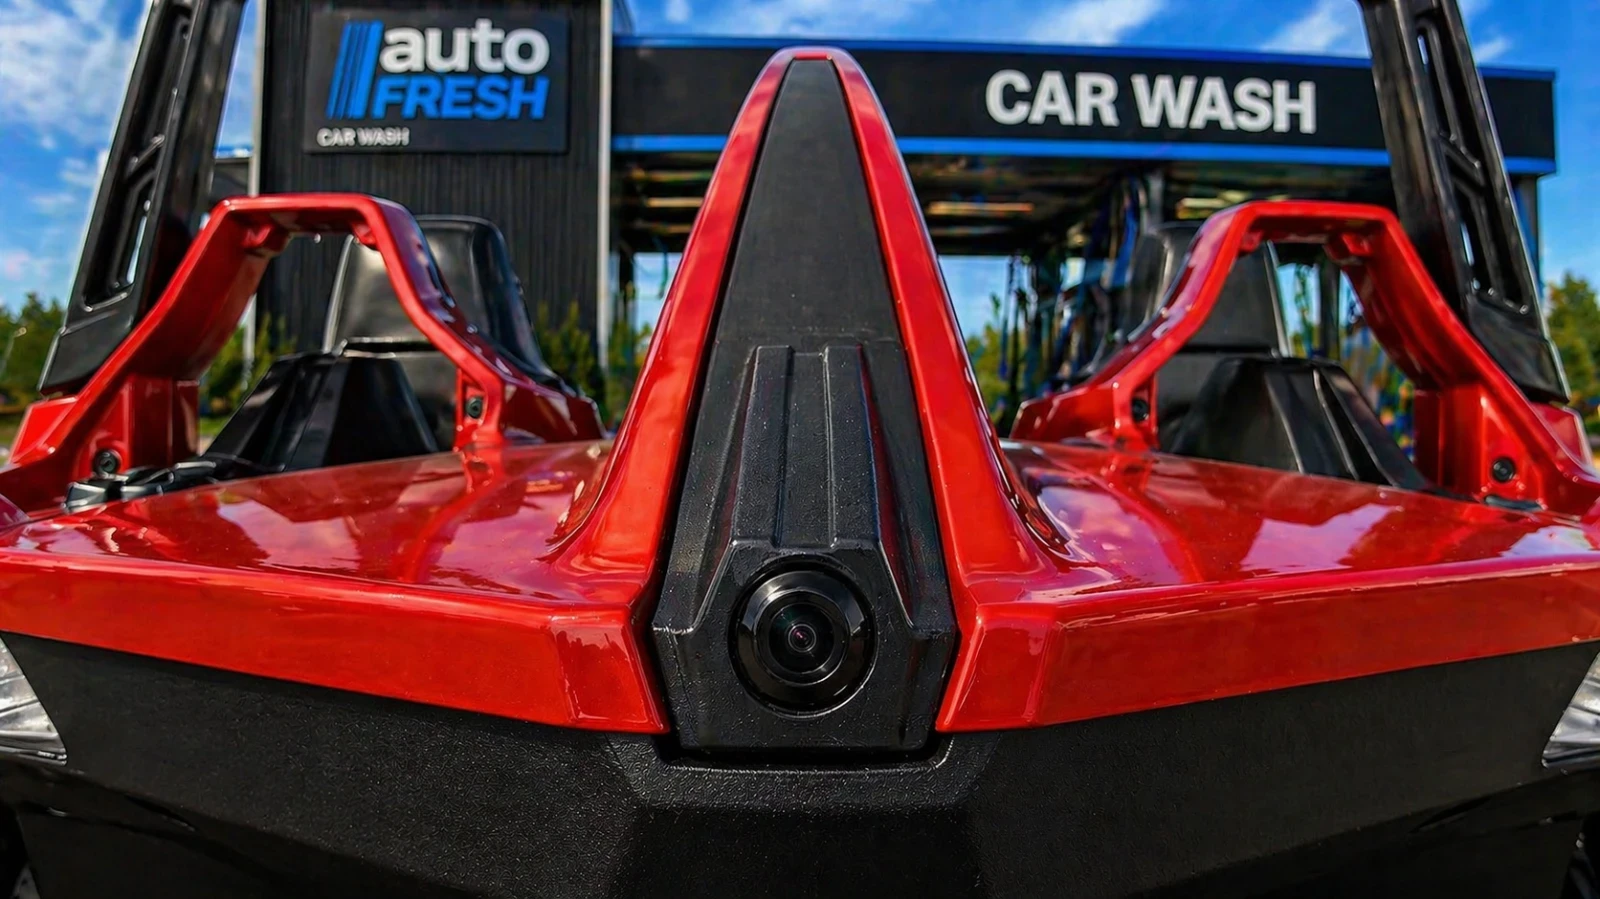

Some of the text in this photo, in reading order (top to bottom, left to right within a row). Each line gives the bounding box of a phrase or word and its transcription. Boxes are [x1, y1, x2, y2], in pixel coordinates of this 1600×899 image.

[379, 18, 550, 74] auto
[371, 75, 549, 120] FRESH
[985, 69, 1316, 134] CAR WASH
[316, 127, 410, 147] CAR WASH
